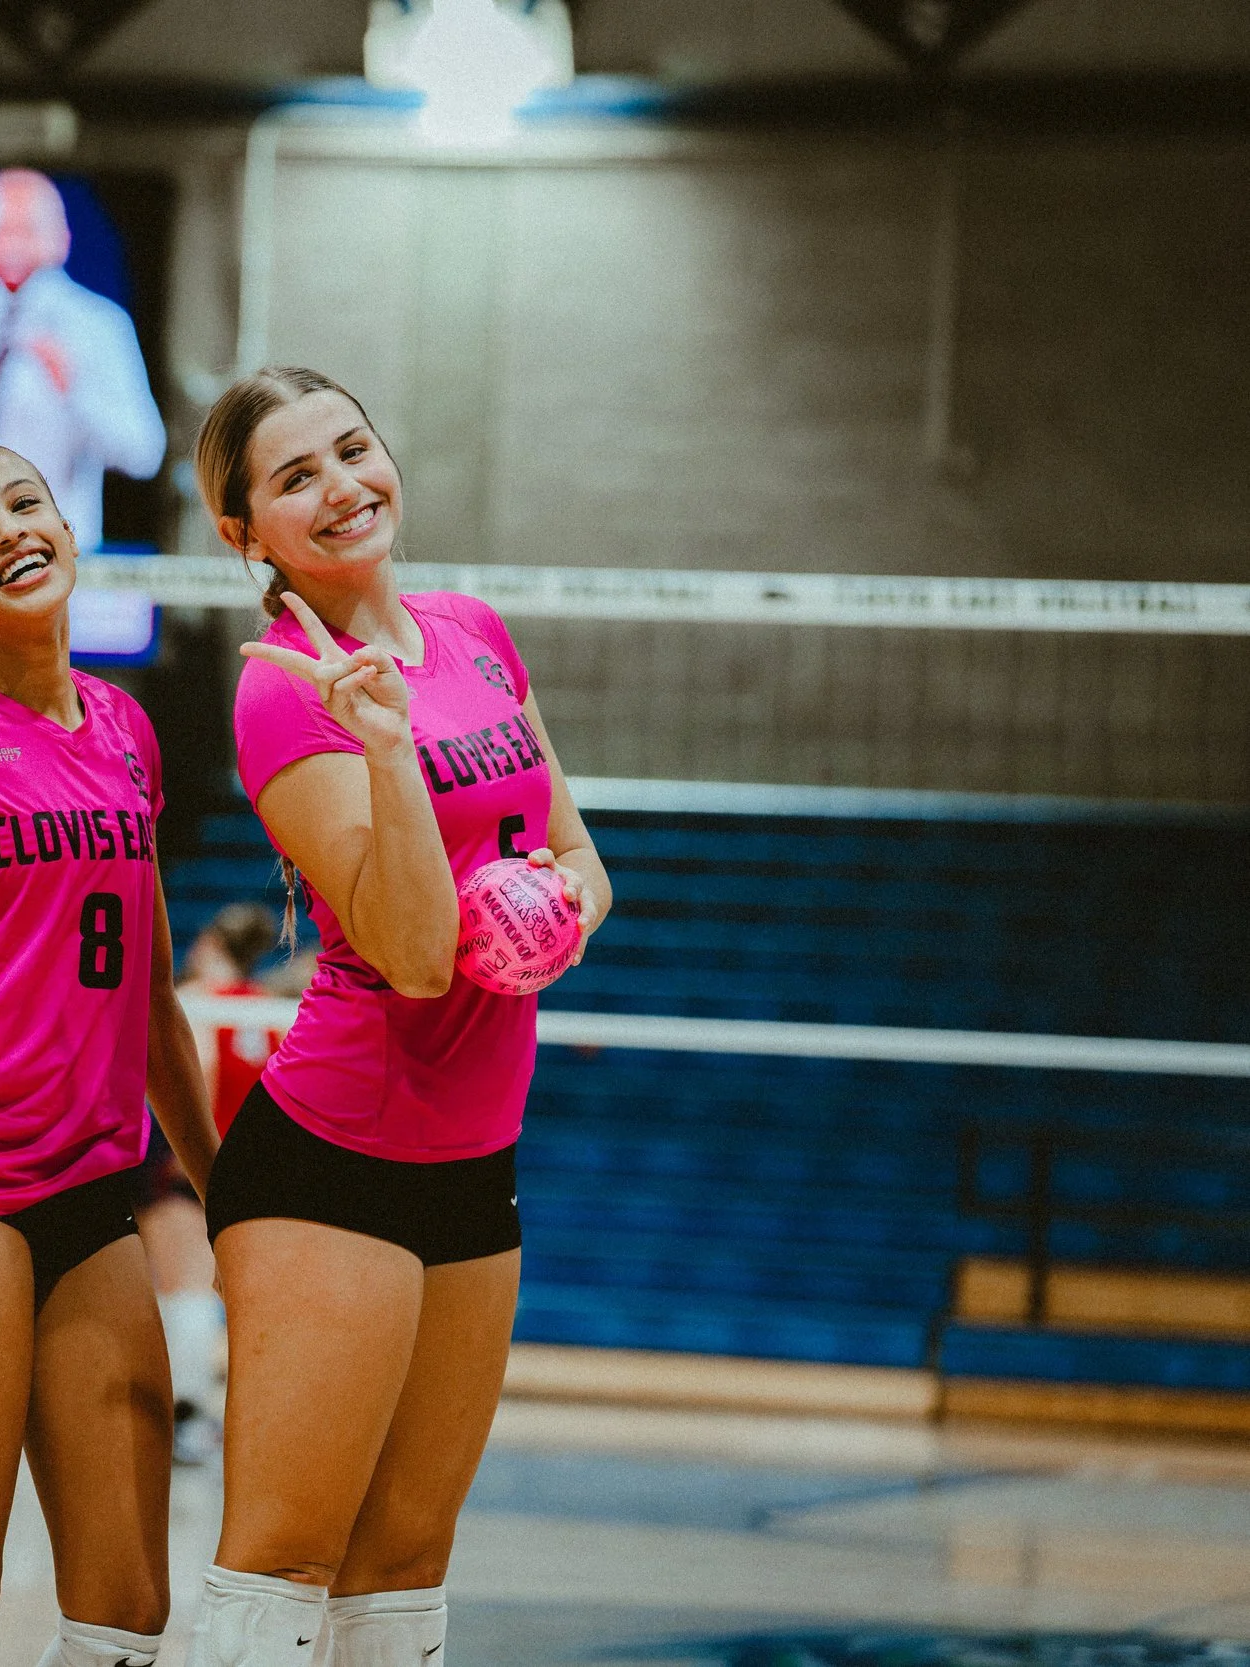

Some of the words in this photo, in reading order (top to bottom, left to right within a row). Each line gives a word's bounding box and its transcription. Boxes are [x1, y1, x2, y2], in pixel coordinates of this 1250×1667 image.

[417, 727, 516, 795] LOVIS
[497, 712, 548, 771] EA
[116, 810, 154, 863] EA
[78, 892, 124, 990] 8
